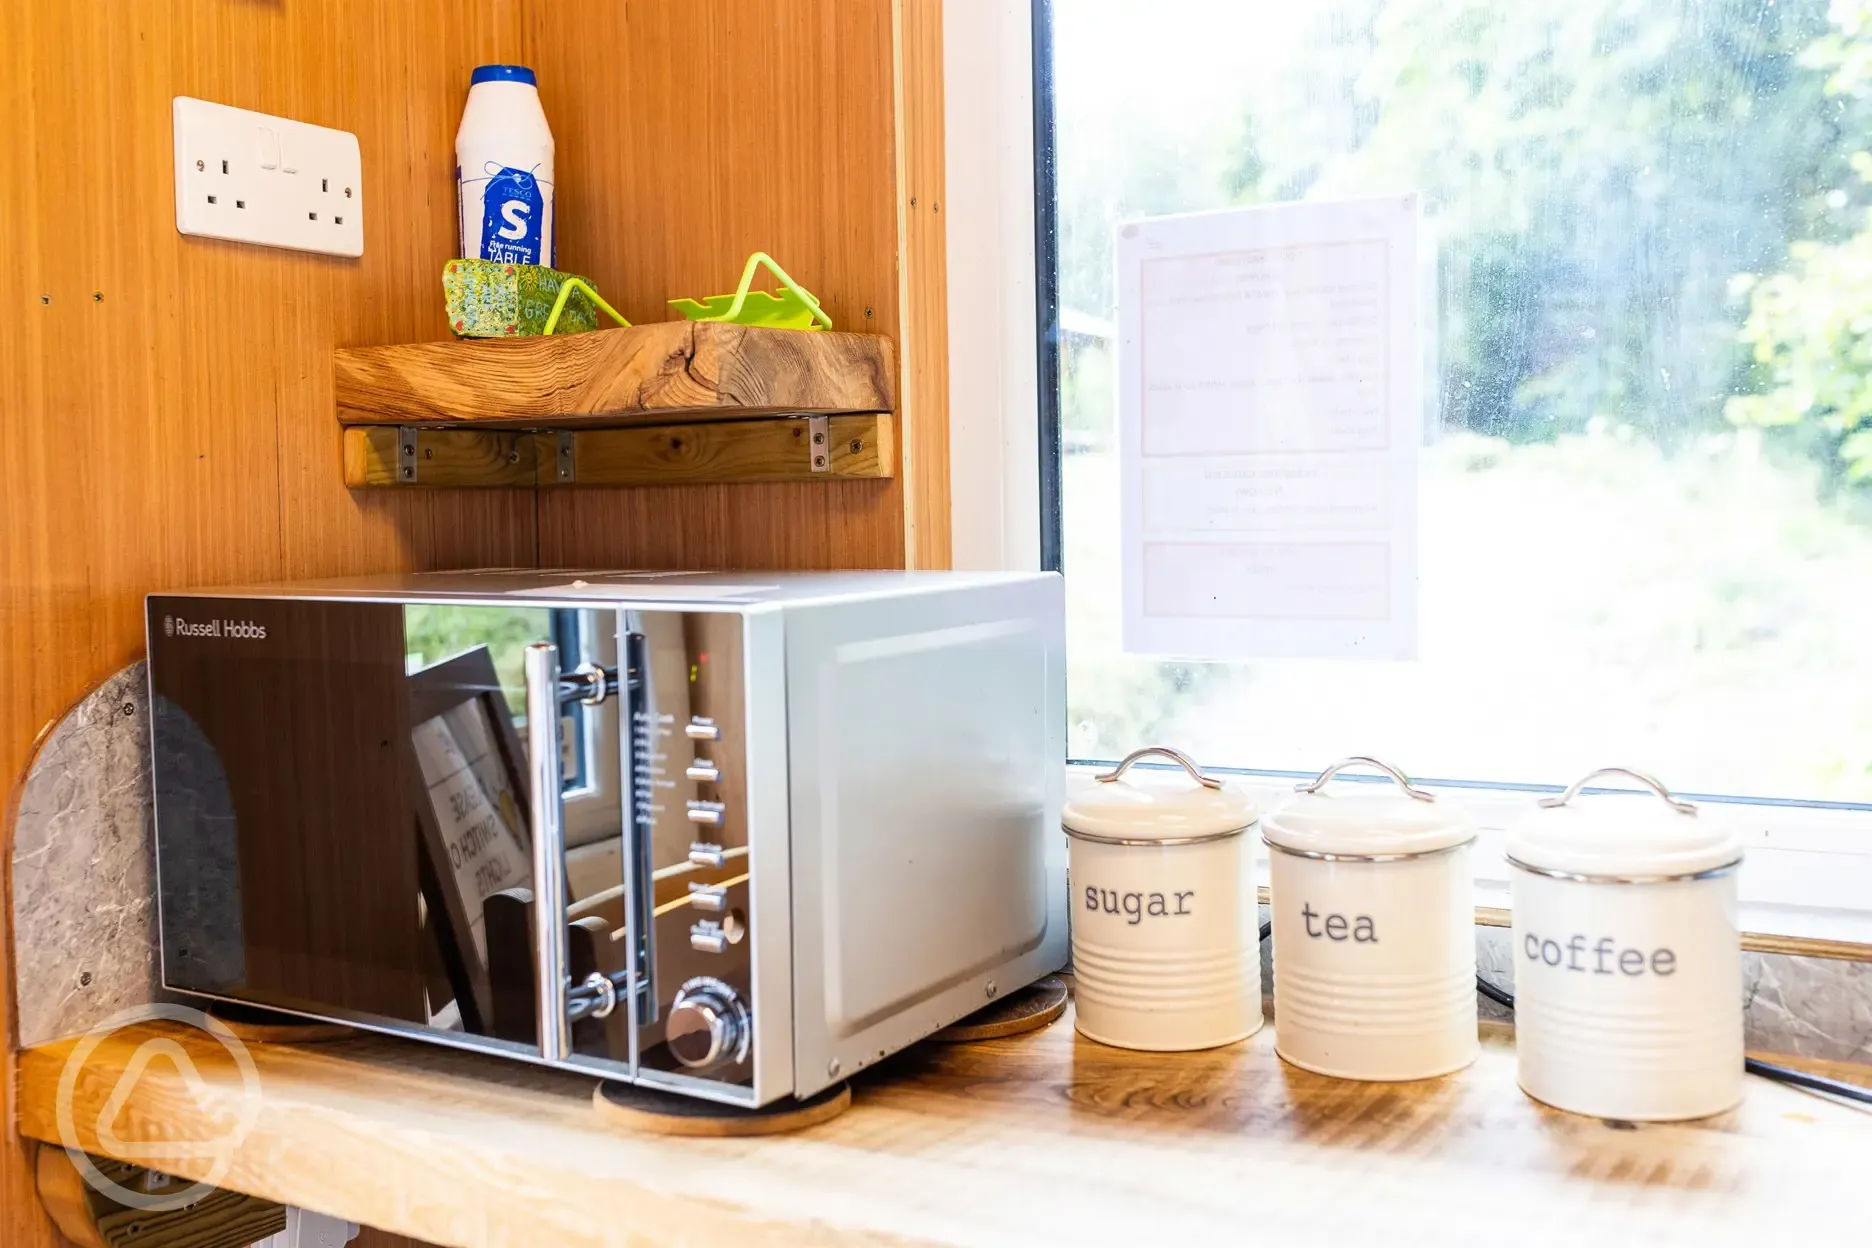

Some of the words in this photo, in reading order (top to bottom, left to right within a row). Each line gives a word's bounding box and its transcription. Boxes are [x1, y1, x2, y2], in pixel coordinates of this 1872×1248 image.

[503, 186, 532, 198] TESCO
[498, 200, 531, 241] S
[504, 243, 532, 255] running
[176, 618, 221, 637] Russell
[223, 619, 267, 639] Hobbs
[1085, 882, 1195, 926] sugar
[1301, 901, 1379, 945] tea
[1523, 928, 1677, 977] coffee
